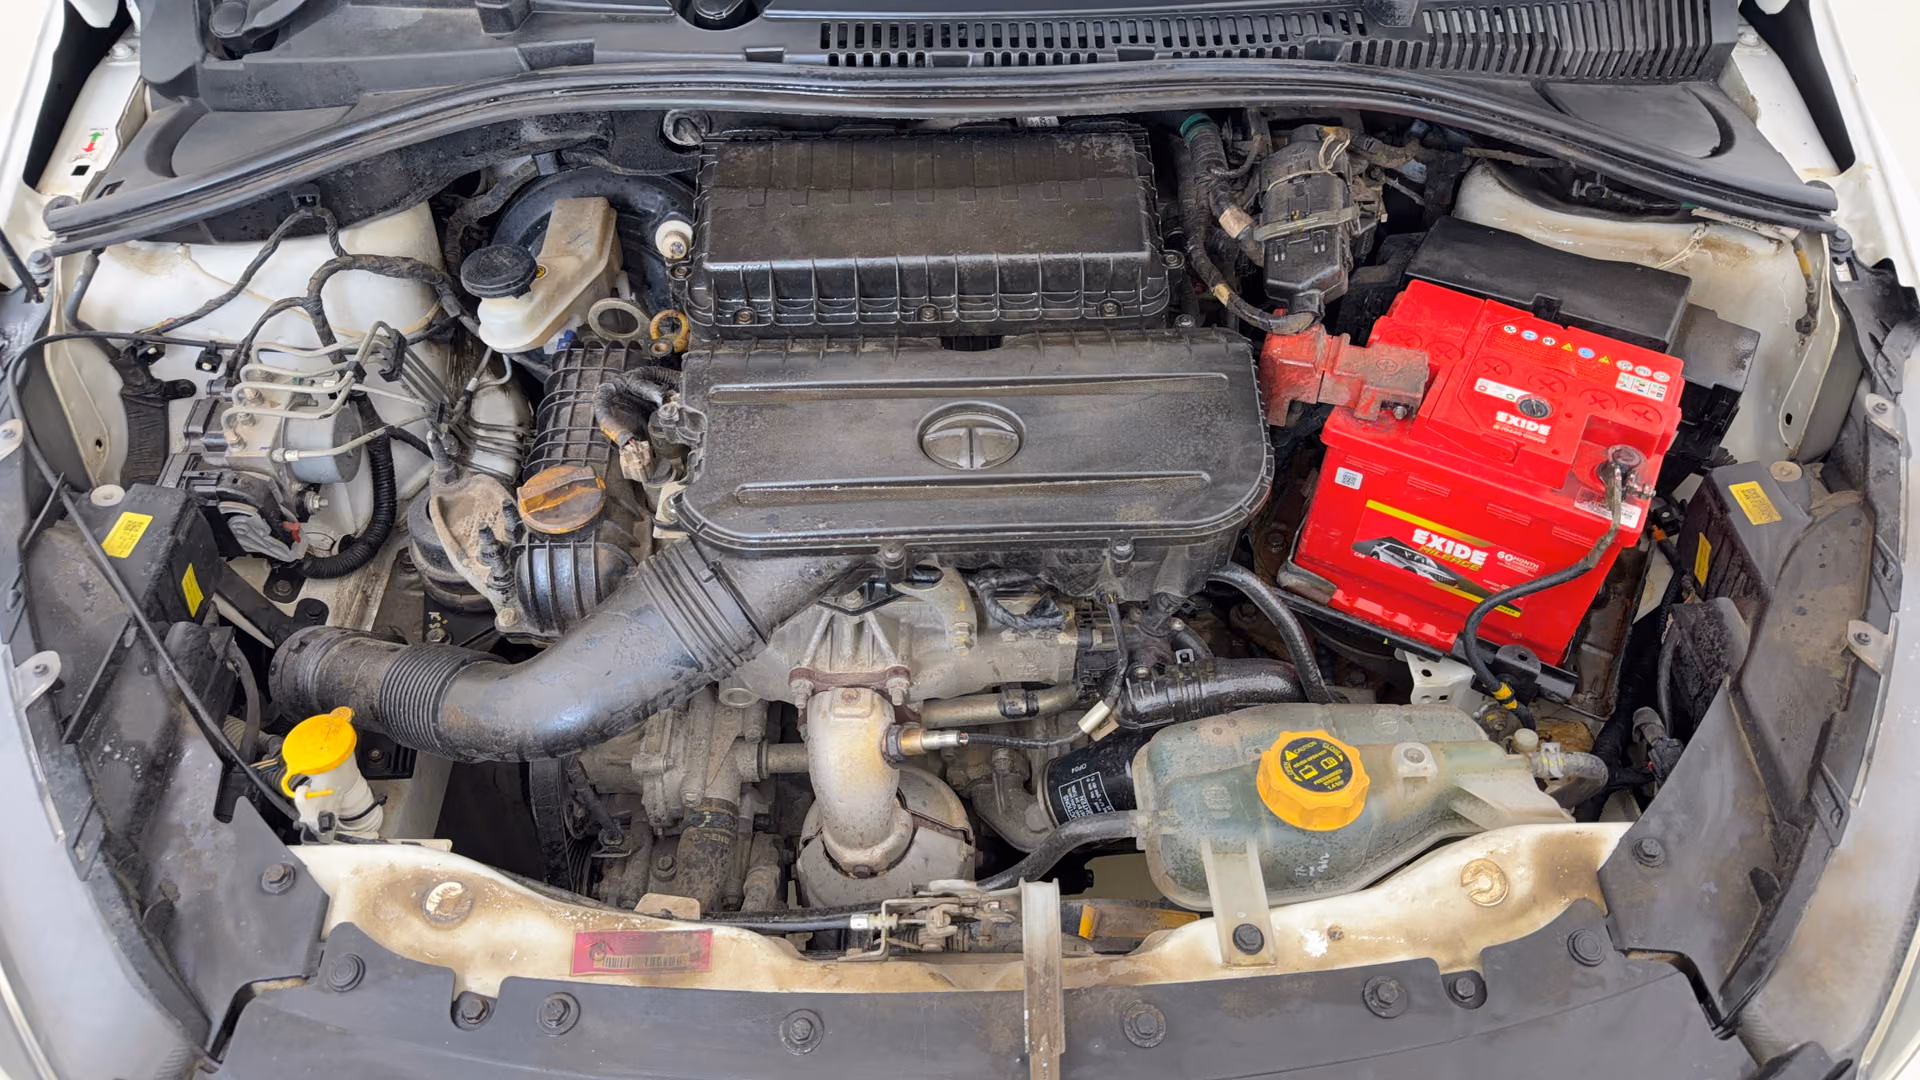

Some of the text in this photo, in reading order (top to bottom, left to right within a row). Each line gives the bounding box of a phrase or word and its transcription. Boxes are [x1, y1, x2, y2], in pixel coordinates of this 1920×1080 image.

[1496, 410, 1551, 437] EXIDE
[1412, 528, 1488, 568] EXIDE
[1497, 551, 1539, 568] 60 MONTH
[1294, 741, 1318, 755] CAUTION
